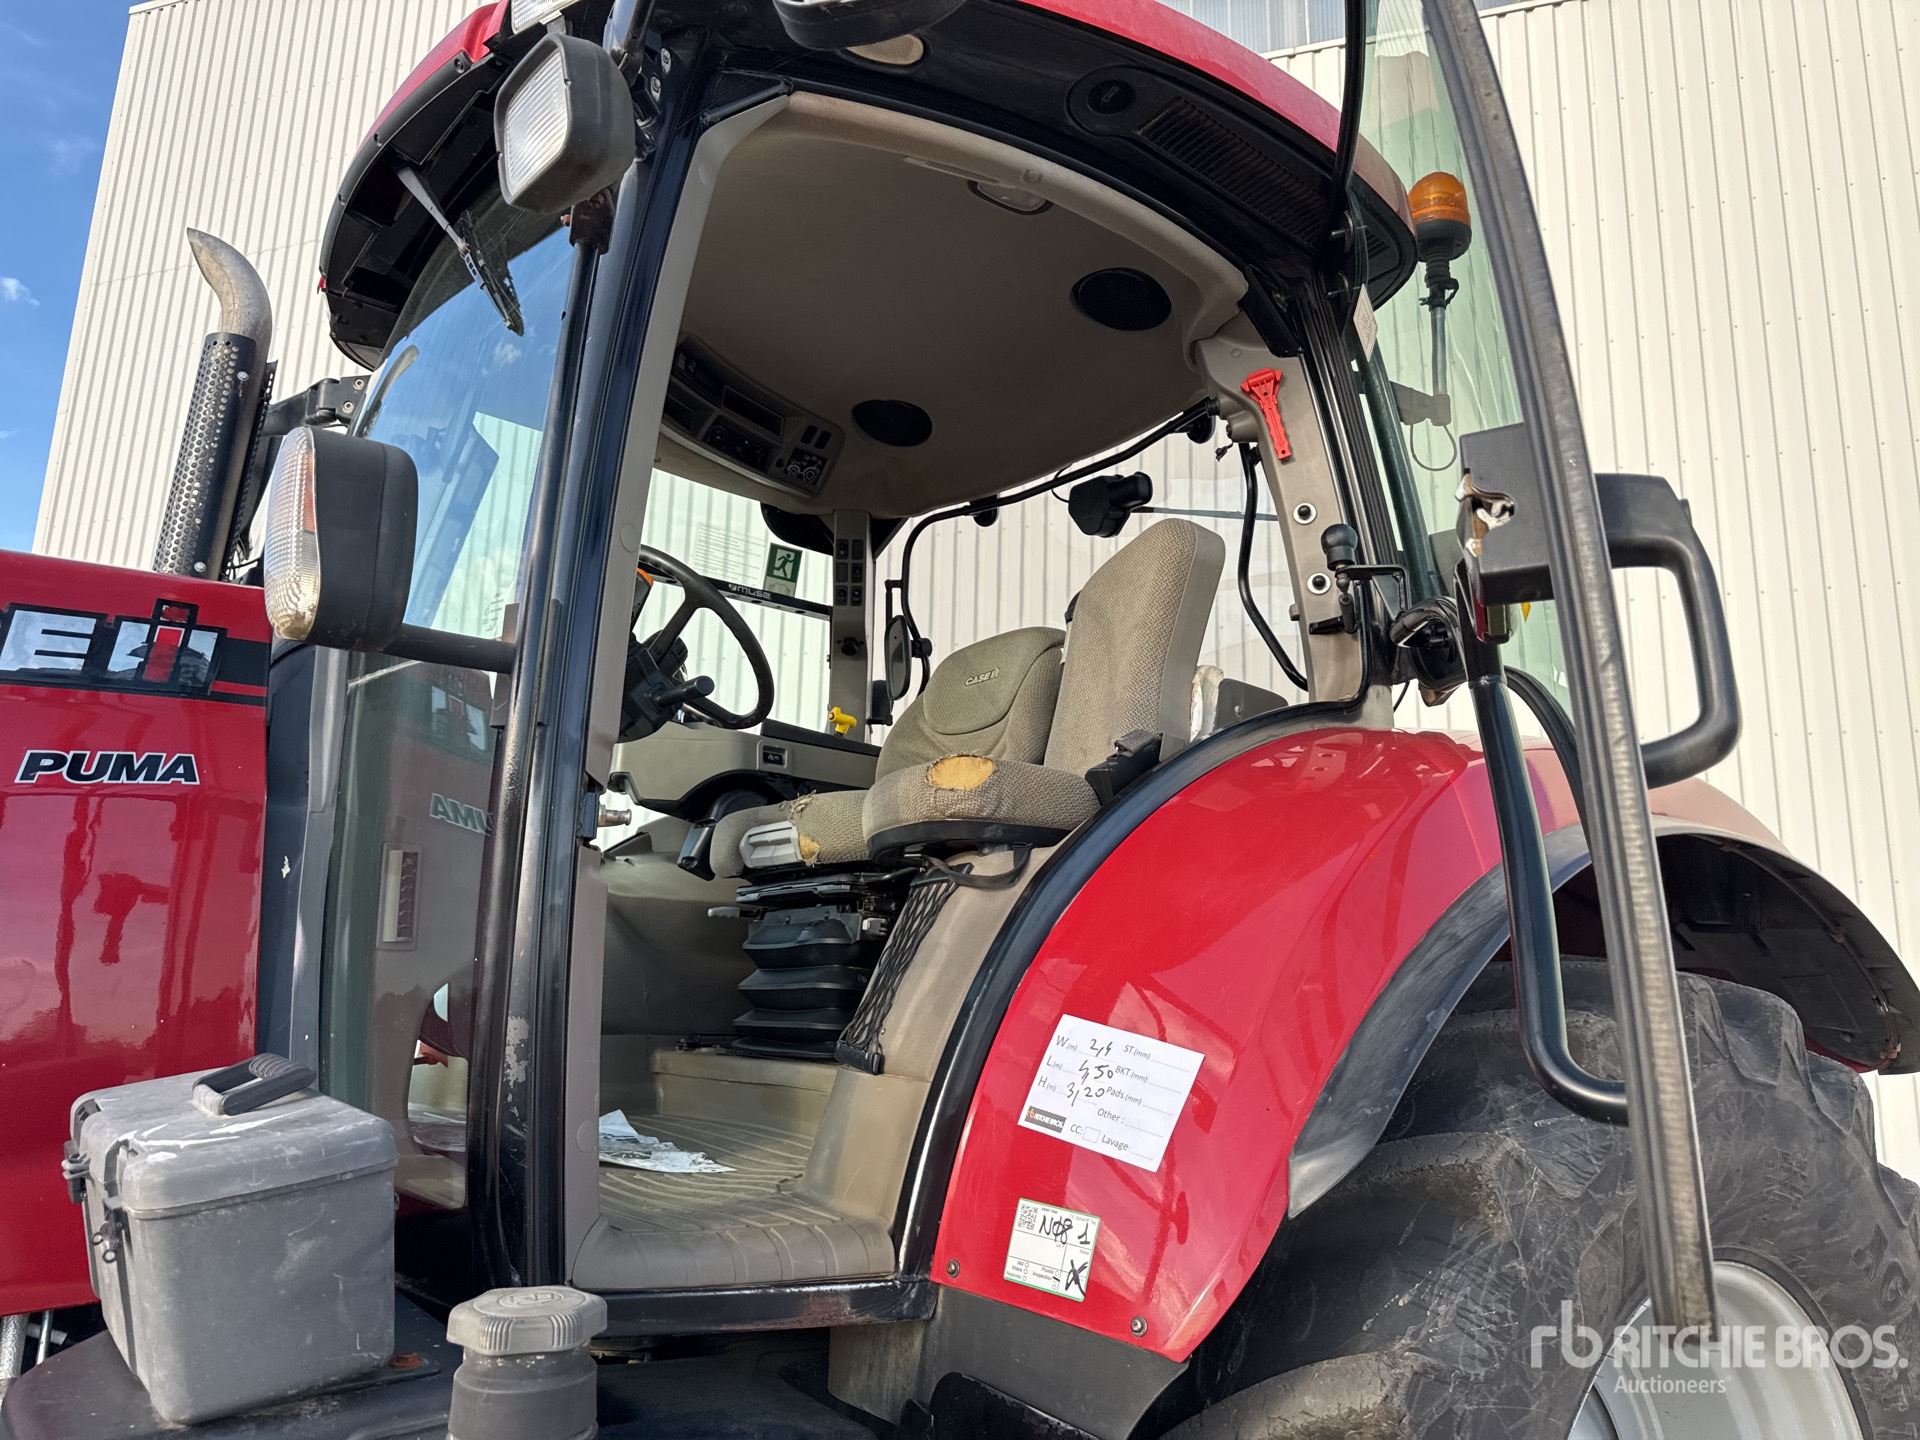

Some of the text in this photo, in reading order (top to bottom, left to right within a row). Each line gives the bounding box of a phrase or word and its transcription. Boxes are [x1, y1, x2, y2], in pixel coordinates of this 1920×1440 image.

[965, 671, 991, 686] CASE
[14, 749, 201, 785] PUMA
[1056, 1034, 1069, 1047] W
[1123, 1044, 1134, 1054] ST
[1115, 1065, 1131, 1077] BKT
[1037, 1076, 1048, 1088] H
[1106, 1086, 1124, 1099] Pads
